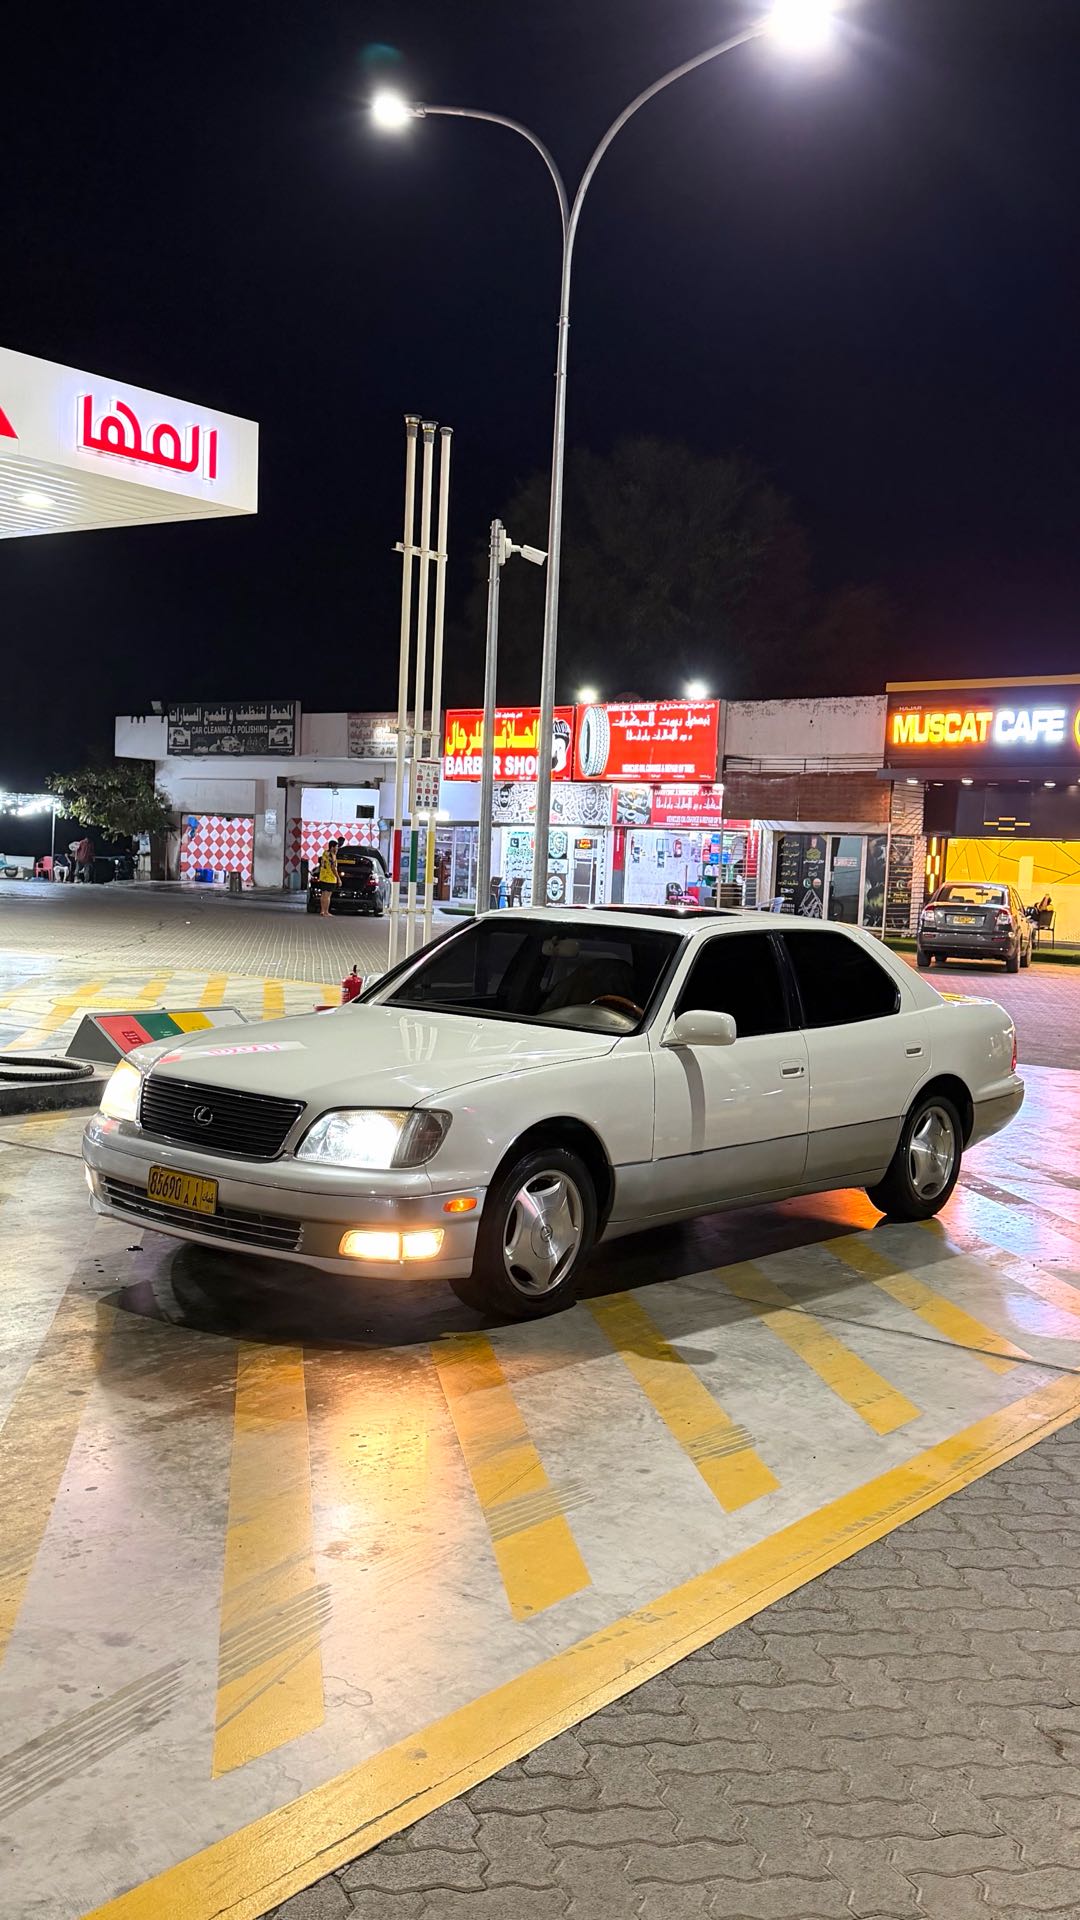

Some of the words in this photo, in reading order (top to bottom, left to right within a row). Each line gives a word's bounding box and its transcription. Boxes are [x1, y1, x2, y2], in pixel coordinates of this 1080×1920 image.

[83, 394, 218, 480] المها
[169, 706, 202, 726] السيارات
[204, 706, 227, 725] تلميع
[228, 708, 234, 725] و
[191, 725, 203, 734] CAR
[204, 725, 232, 734] CLEANING
[233, 725, 237, 734] &
[237, 725, 268, 734] POLISHING
[892, 711, 993, 744] MUSCAT
[994, 709, 1066, 742] CAFE
[445, 755, 501, 776] BARBR
[504, 755, 540, 776] SHO
[150, 1172, 181, 1200] 85690
